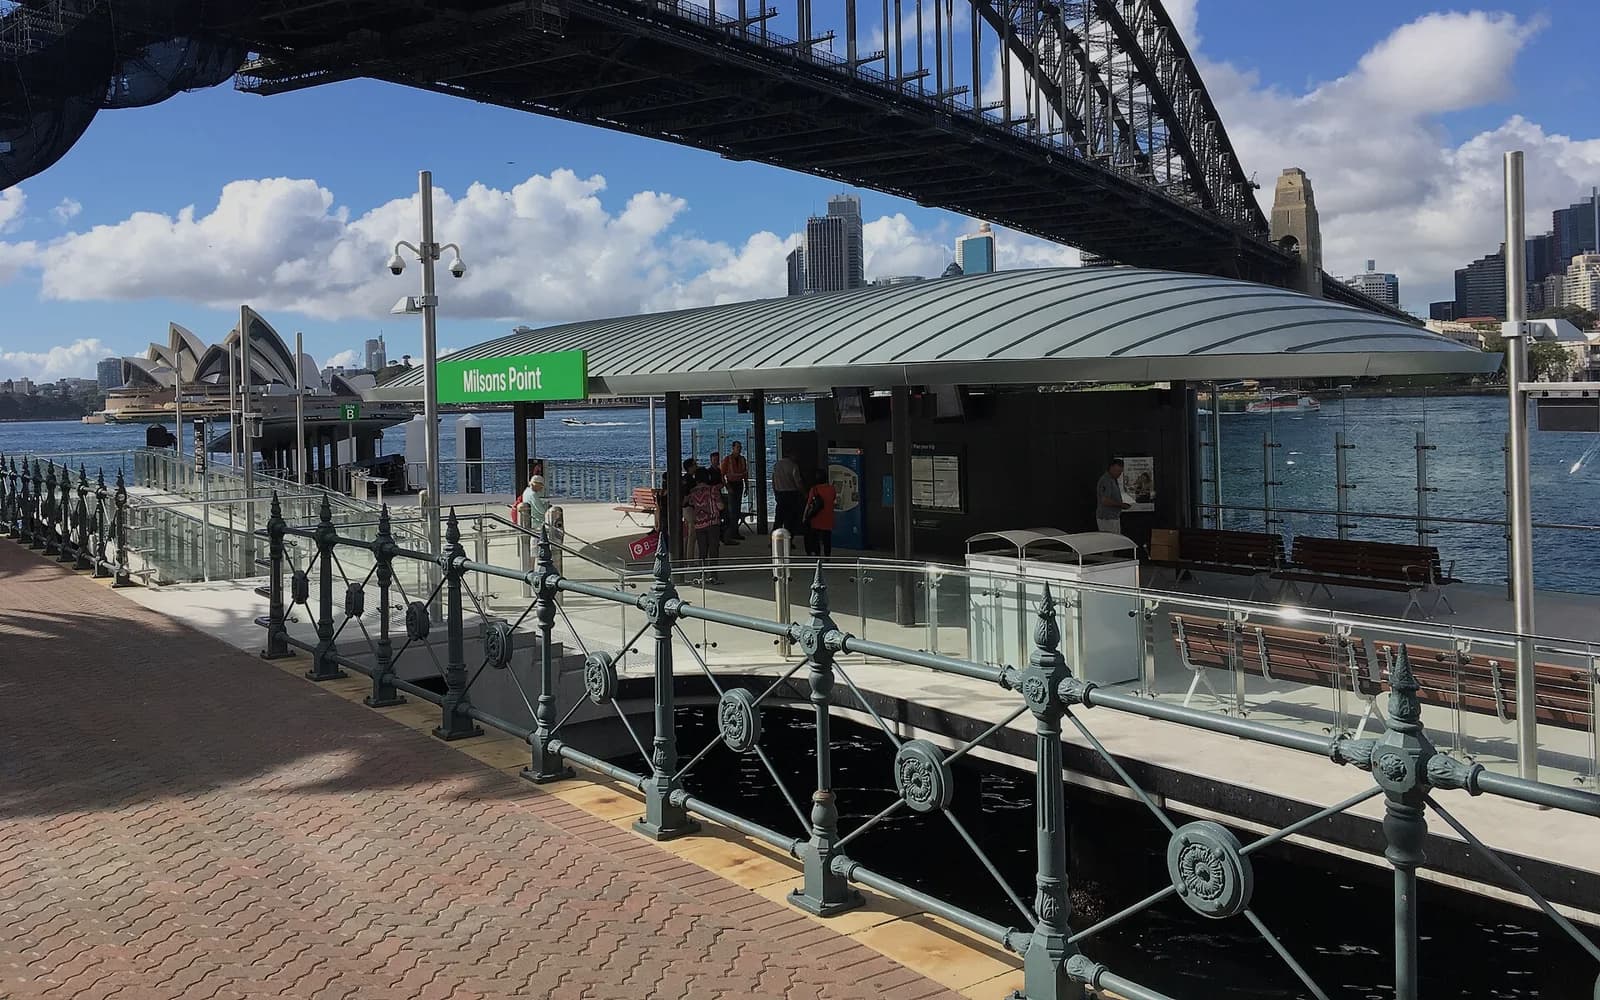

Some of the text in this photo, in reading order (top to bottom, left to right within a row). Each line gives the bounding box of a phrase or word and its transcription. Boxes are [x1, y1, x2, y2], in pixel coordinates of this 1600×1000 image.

[464, 365, 542, 392] Milsons Point
[347, 410, 354, 420] B
